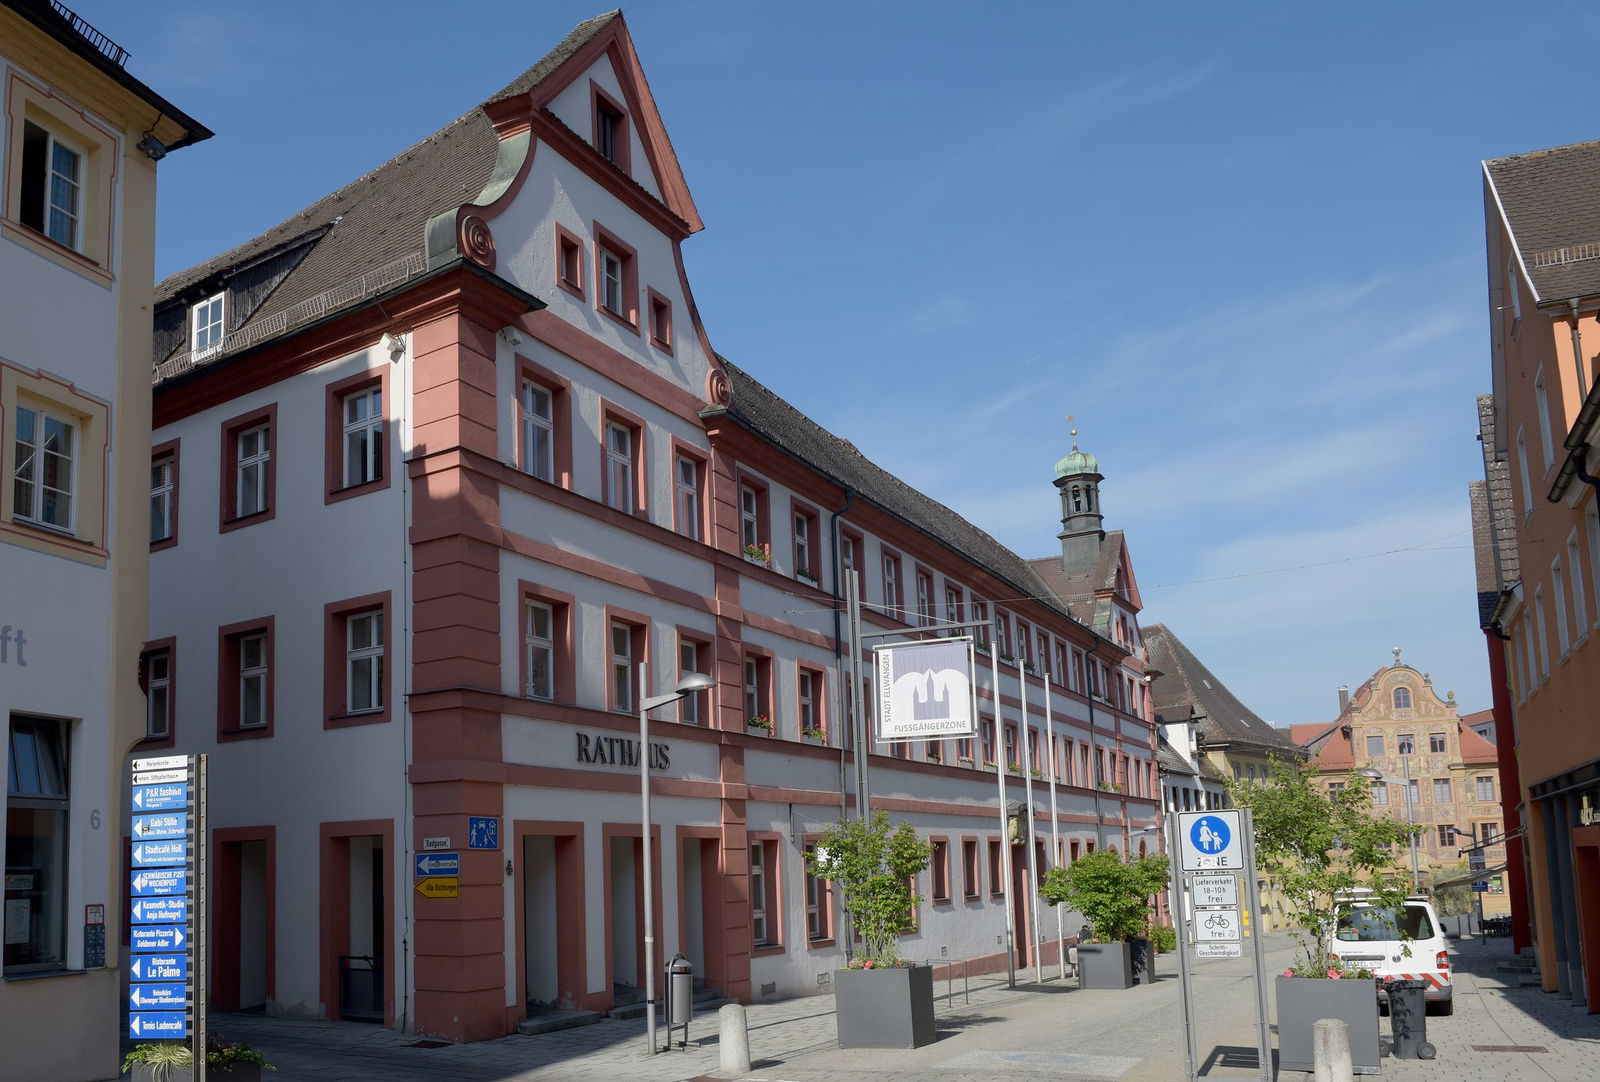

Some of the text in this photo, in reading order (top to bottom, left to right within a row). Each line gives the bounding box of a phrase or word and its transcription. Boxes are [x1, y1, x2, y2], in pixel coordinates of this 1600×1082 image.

[882, 654, 892, 723] STADT ELLWANGEN
[894, 720, 967, 732] FUSSGÄNGERZONE
[160, 787, 181, 796] fashion
[90, 809, 101, 830] 6
[426, 840, 447, 848] Badgasse
[145, 845, 170, 854] Stadtcafé
[1197, 856, 1228, 867] ZNE
[1195, 878, 1233, 886] Lieferverkehr
[134, 930, 155, 938] Ristorante
[1210, 930, 1225, 938] frei
[152, 958, 176, 966] Ristorante
[148, 966, 181, 977] Le Palme
[143, 1021, 155, 1030] Tonis
